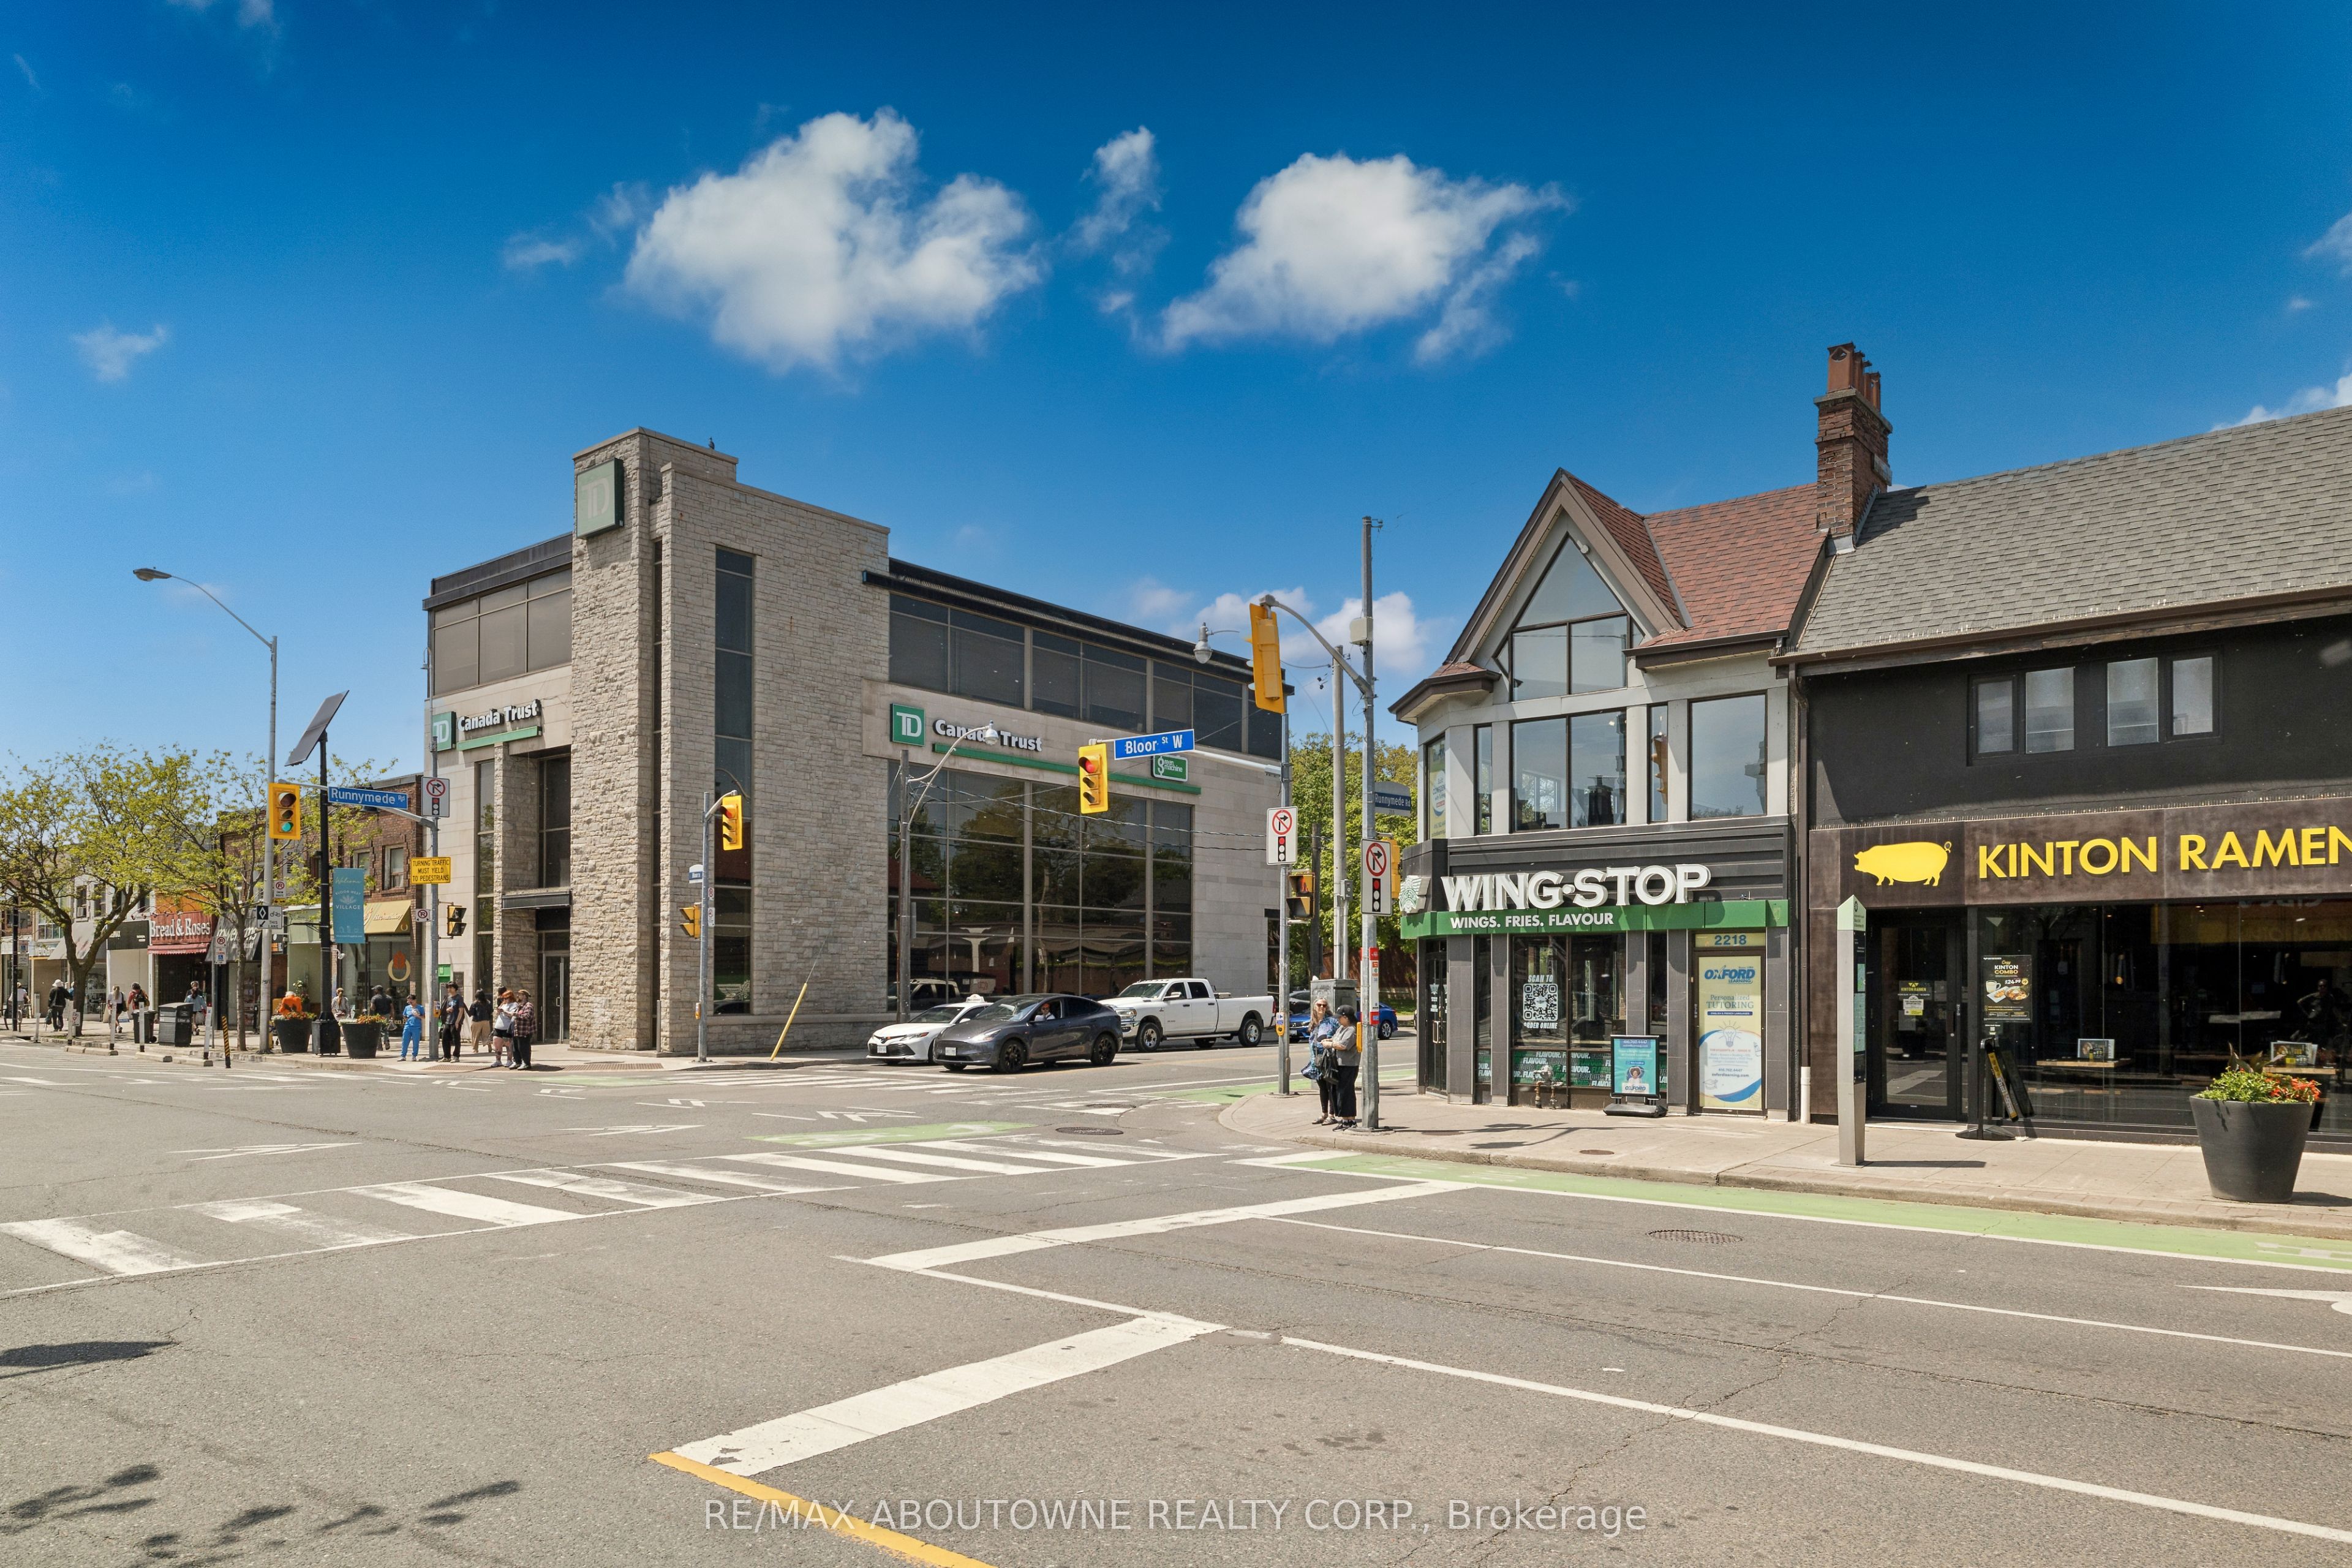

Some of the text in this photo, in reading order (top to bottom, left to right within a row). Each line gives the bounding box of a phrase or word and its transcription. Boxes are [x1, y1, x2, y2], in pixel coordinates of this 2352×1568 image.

[581, 478, 610, 518] TD
[433, 699, 538, 744] TD Canada Trust
[896, 712, 1042, 752] TD Canad Trust
[1125, 740, 1157, 755] Bloor
[1172, 734, 1183, 748] W
[331, 788, 395, 804] Runnymede
[1374, 793, 1411, 807] Runnymede Rd
[1978, 836, 2158, 879] KINTON
[150, 919, 175, 938] Bread
[176, 919, 184, 937] &
[185, 918, 211, 936] Roses
[1450, 913, 1614, 929] WINGS. FRIES. FLAVOUR
[1714, 934, 1747, 946] 2218
[1528, 974, 1545, 983] SCAN
[1704, 966, 1755, 980] OXFORD
